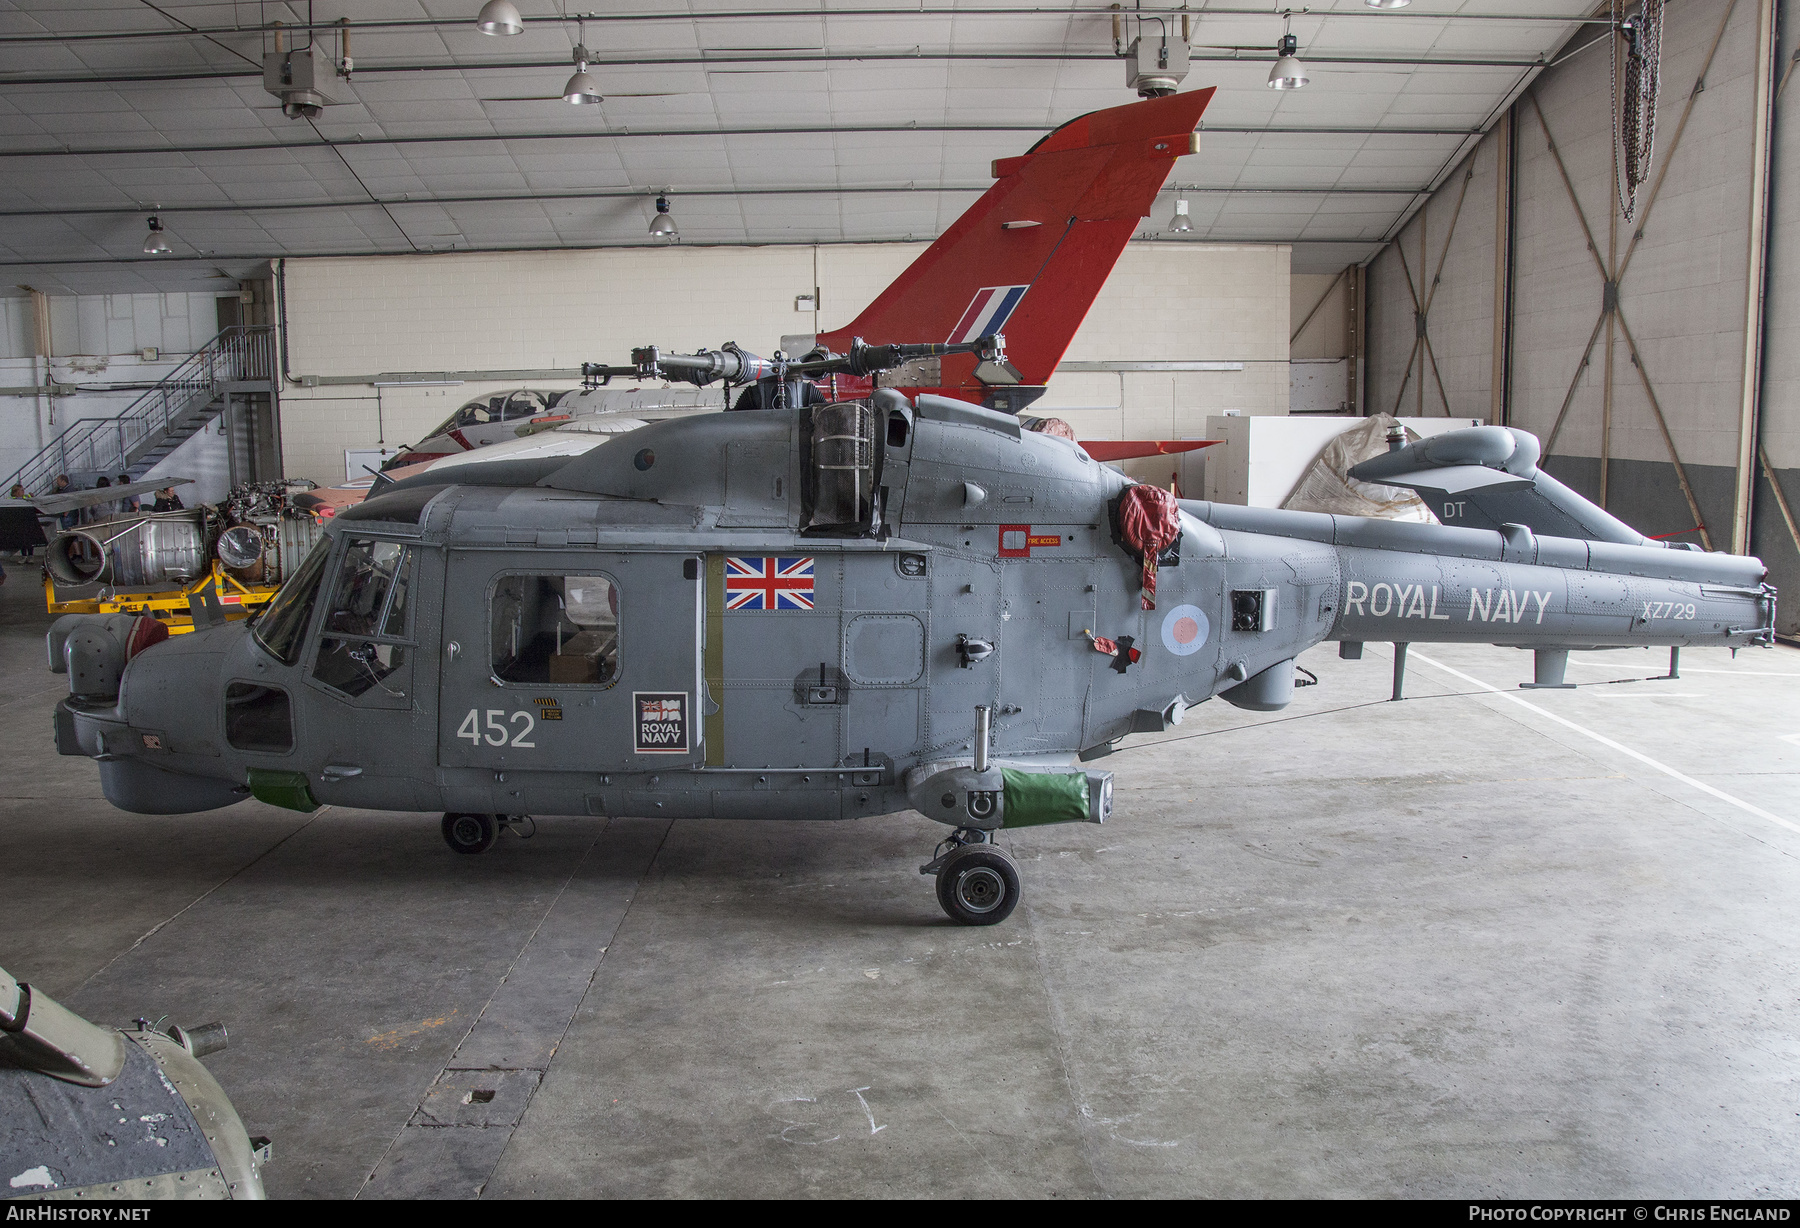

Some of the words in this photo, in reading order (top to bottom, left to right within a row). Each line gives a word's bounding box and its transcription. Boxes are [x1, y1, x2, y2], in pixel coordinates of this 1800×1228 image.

[1443, 501, 1467, 518] DT
[1040, 537, 1059, 545] ACCESS
[1344, 580, 1450, 621] ROYAL
[1467, 587, 1552, 625] NAVY
[1642, 601, 1696, 620] XZ729
[457, 708, 536, 748] 452
[641, 723, 681, 733] ROYAL
[641, 732, 681, 743] NAVY
